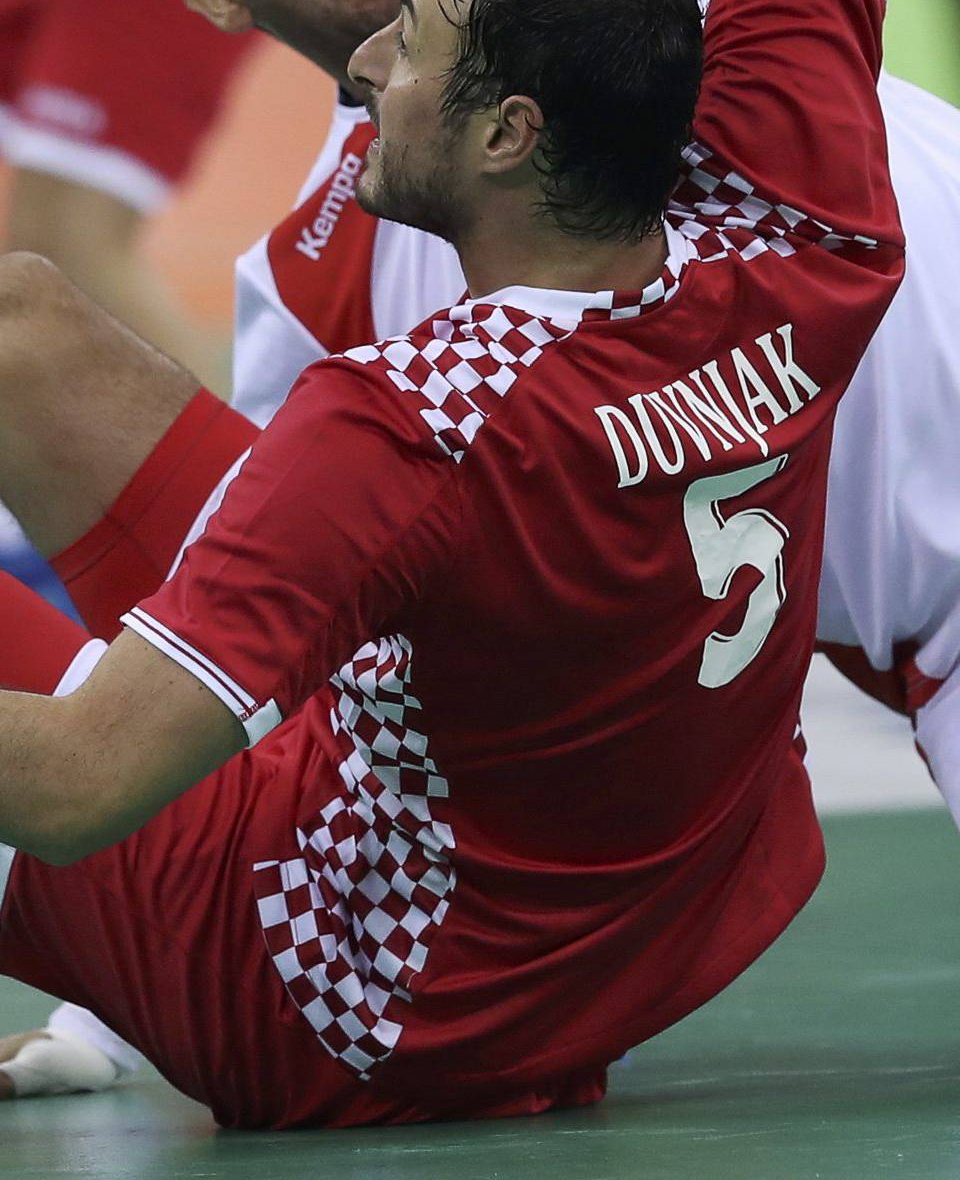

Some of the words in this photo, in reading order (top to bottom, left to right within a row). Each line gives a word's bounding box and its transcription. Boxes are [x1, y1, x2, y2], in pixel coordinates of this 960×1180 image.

[296, 153, 362, 260] Kempa
[594, 323, 821, 488] DUVNJAK
[683, 454, 789, 688] 5
